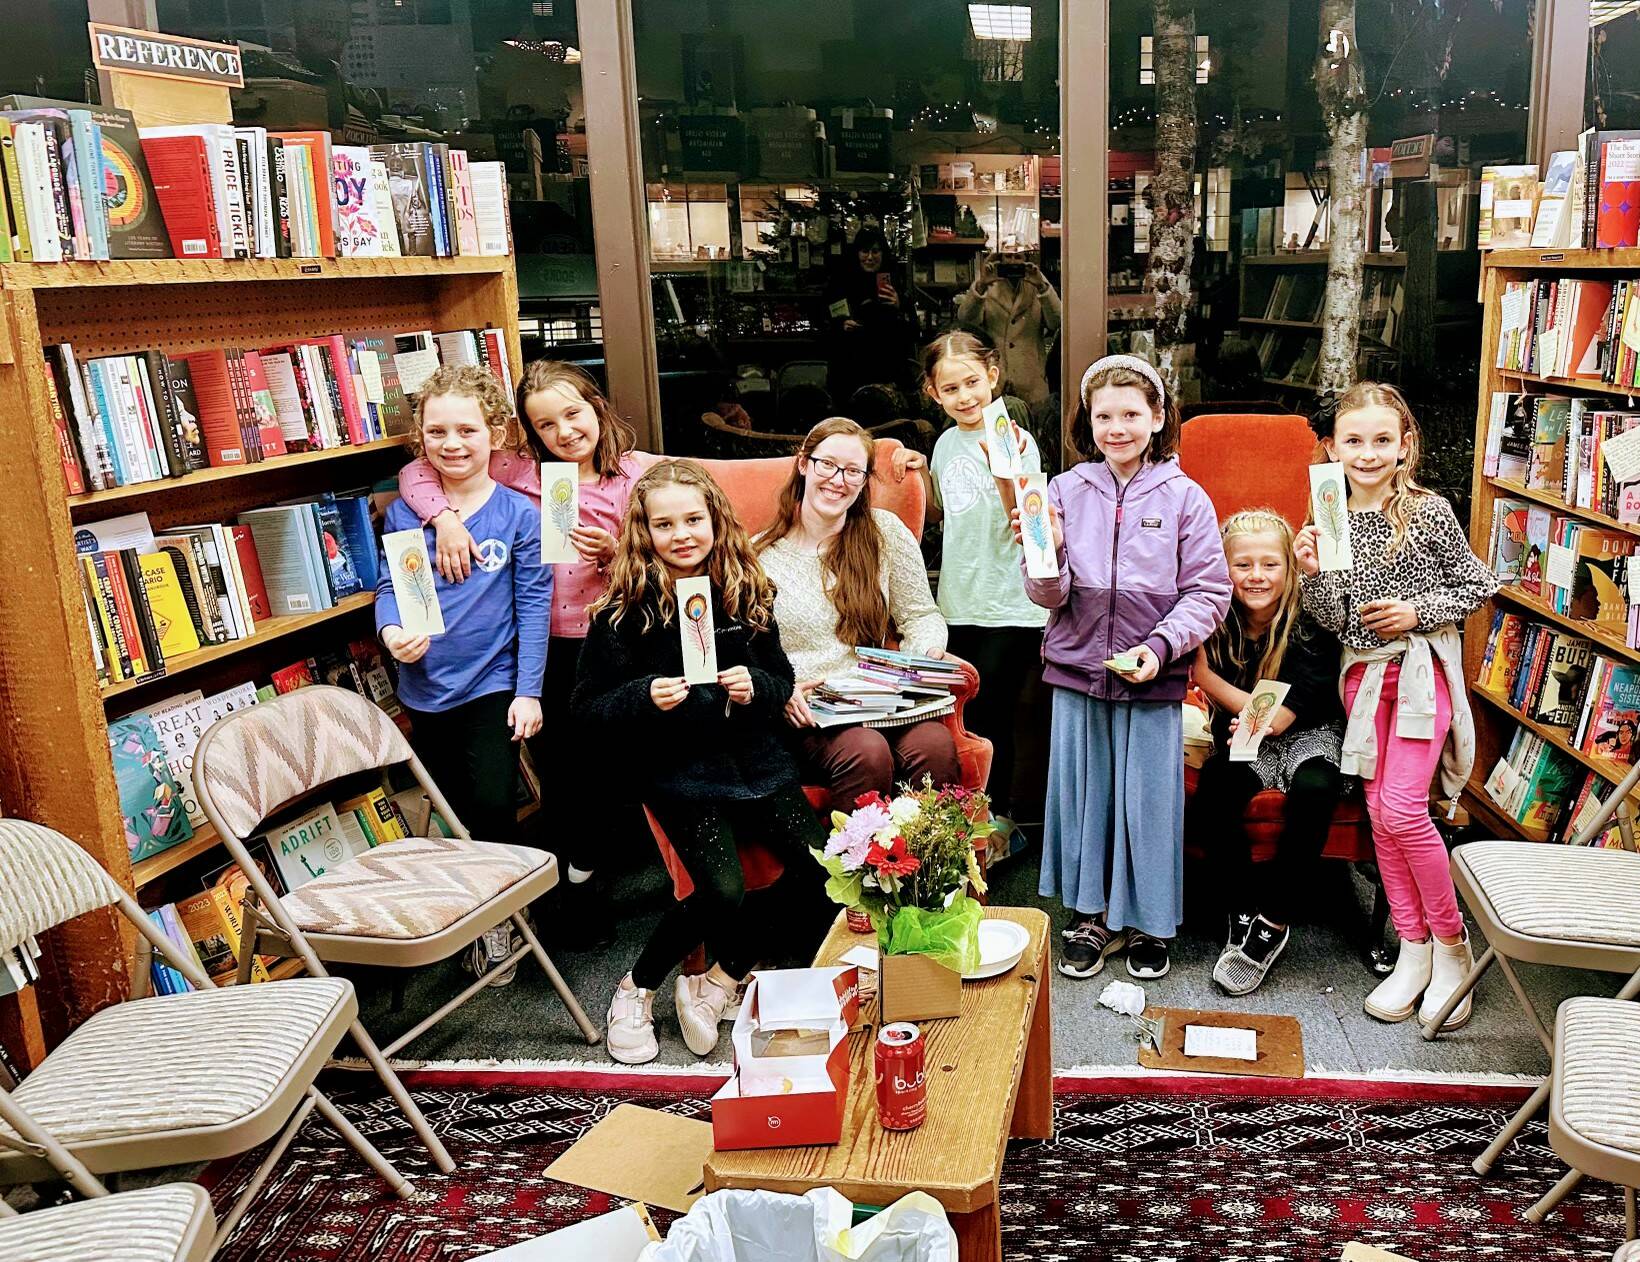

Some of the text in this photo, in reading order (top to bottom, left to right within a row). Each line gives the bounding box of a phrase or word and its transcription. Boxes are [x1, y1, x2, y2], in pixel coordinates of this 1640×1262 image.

[97, 33, 241, 76] REFERENCE
[46, 131, 62, 193] BODY LANGUAGE
[223, 150, 245, 247] PRICE TICKET
[335, 178, 367, 205] OY
[353, 237, 372, 246] GAY
[478, 331, 488, 361] WHITE
[157, 370, 165, 388] HOW
[48, 377, 62, 420] WANTING
[163, 390, 169, 401] TO
[165, 404, 173, 423] TELL
[171, 433, 181, 458] STORY
[144, 576, 163, 586] ARIO
[102, 577, 112, 601] CRAFT
[112, 615, 128, 657] CONSCIENCE
[1555, 647, 1586, 665] BUR
[1614, 683, 1640, 695] NEAPO
[1618, 693, 1640, 704] SISTE
[157, 706, 201, 736] REAT
[280, 815, 332, 857] ADRIFT
[188, 898, 210, 912] 2023
[225, 905, 242, 936] WORLD
[895, 1063, 925, 1090] bub
